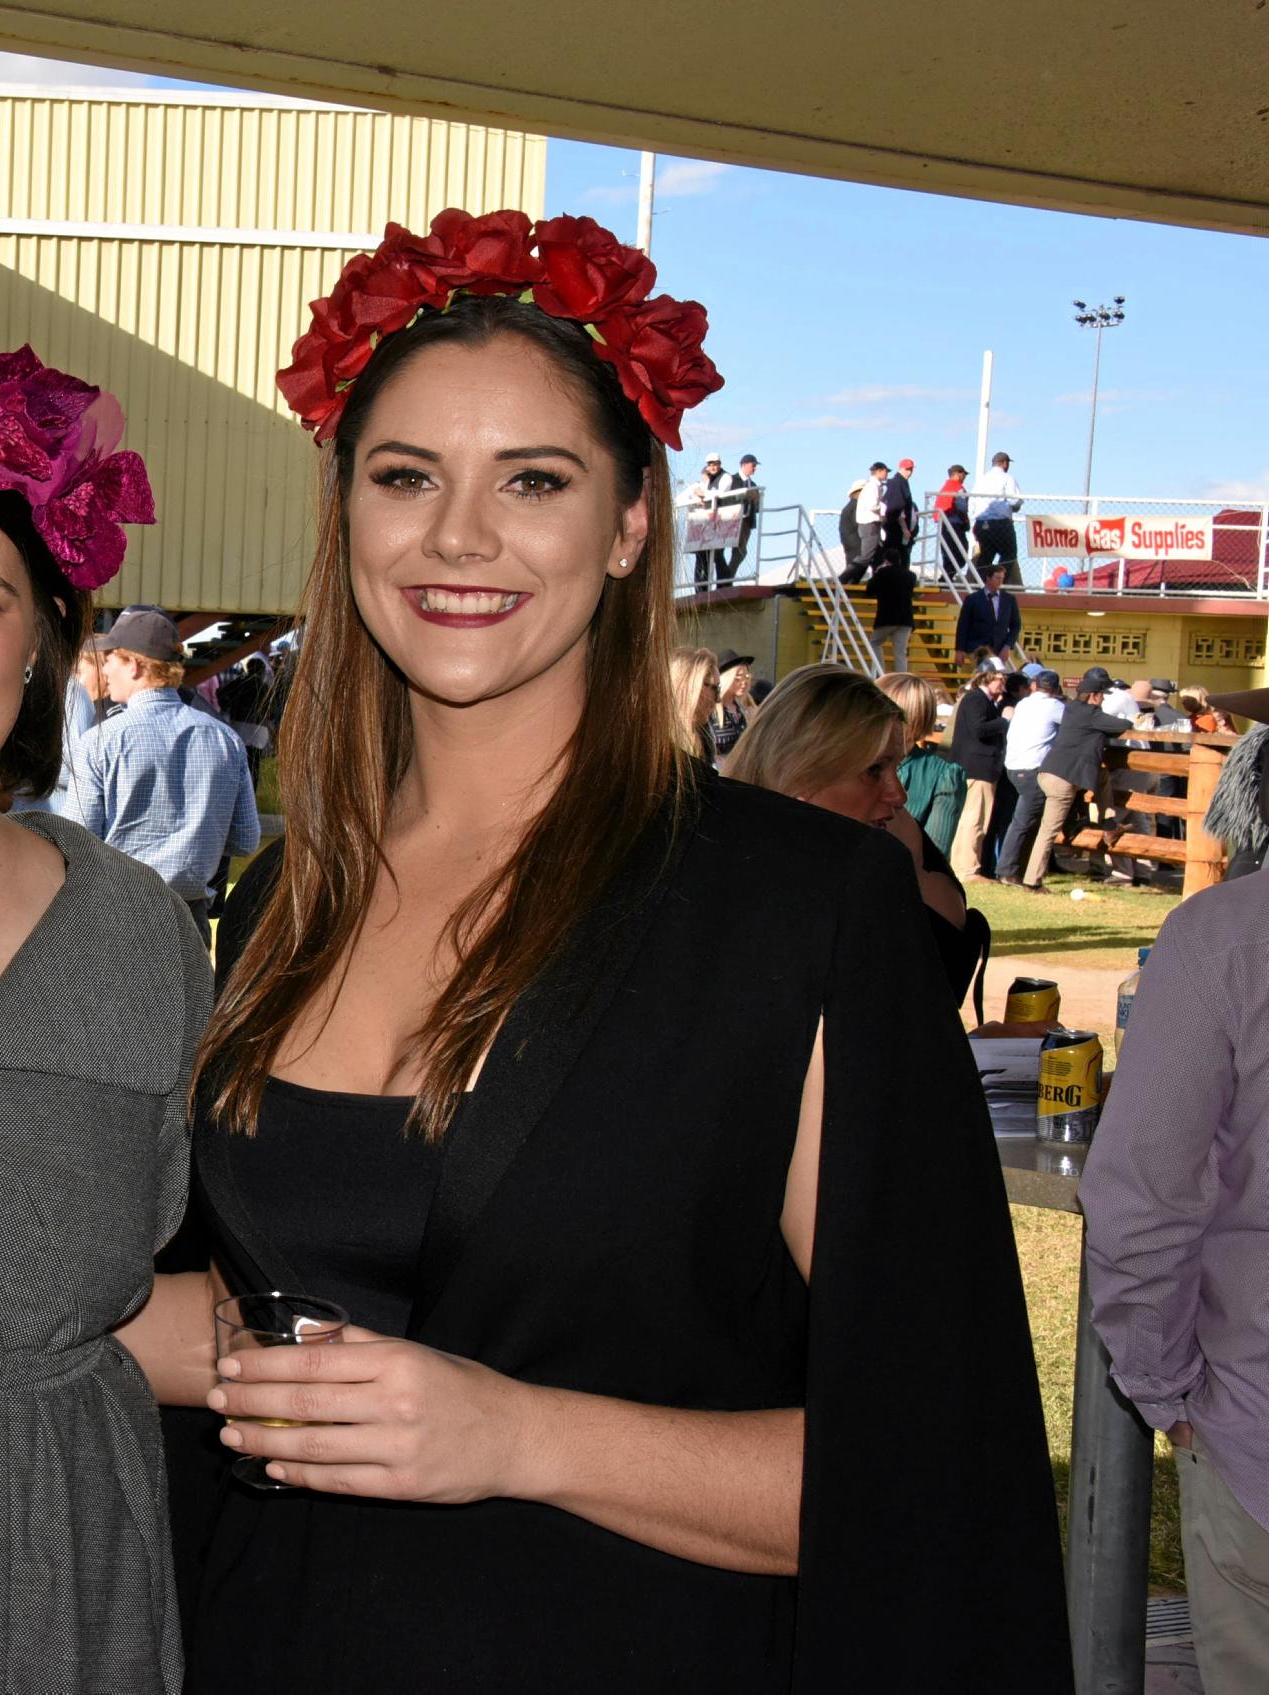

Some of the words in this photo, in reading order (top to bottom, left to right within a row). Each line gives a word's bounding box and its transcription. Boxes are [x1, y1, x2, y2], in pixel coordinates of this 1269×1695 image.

[1033, 520, 1078, 548] Roma
[1089, 520, 1121, 551] Gas
[1131, 521, 1205, 556] Supplies
